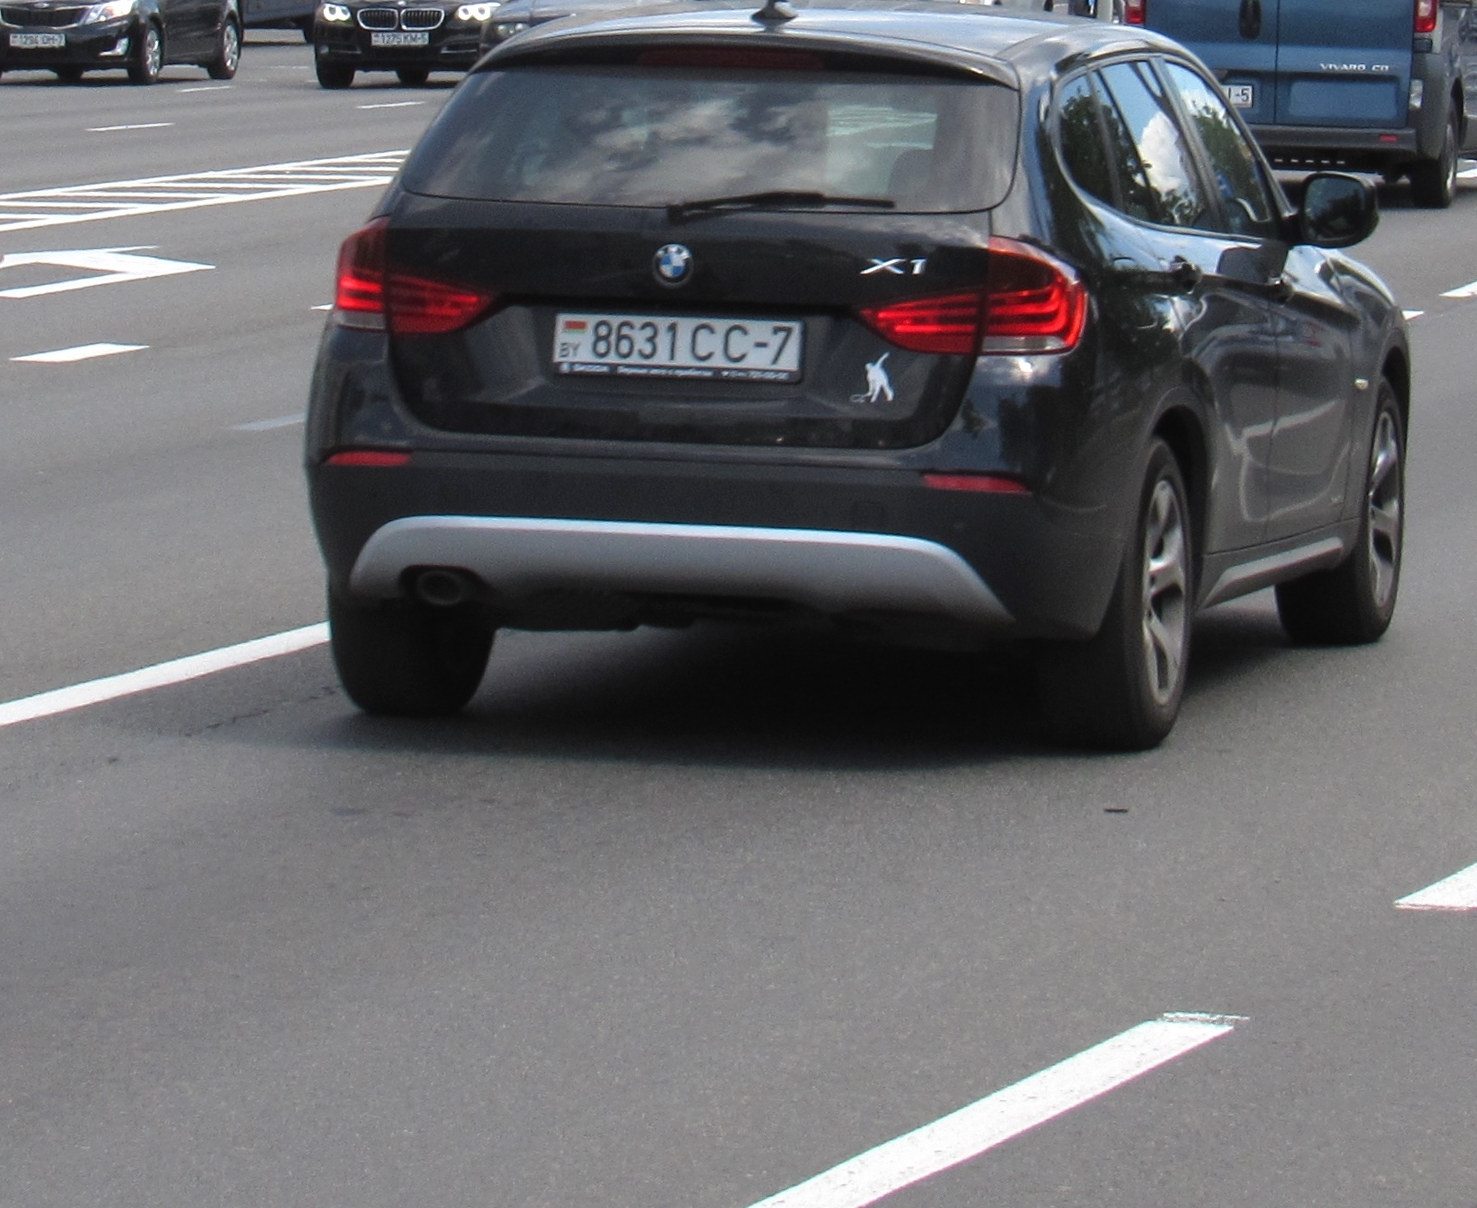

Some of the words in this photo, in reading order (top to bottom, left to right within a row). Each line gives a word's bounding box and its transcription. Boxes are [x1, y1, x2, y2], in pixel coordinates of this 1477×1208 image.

[1320, 63, 1366, 71] VIVARO
[860, 258, 927, 275] X1
[558, 342, 581, 358] BY
